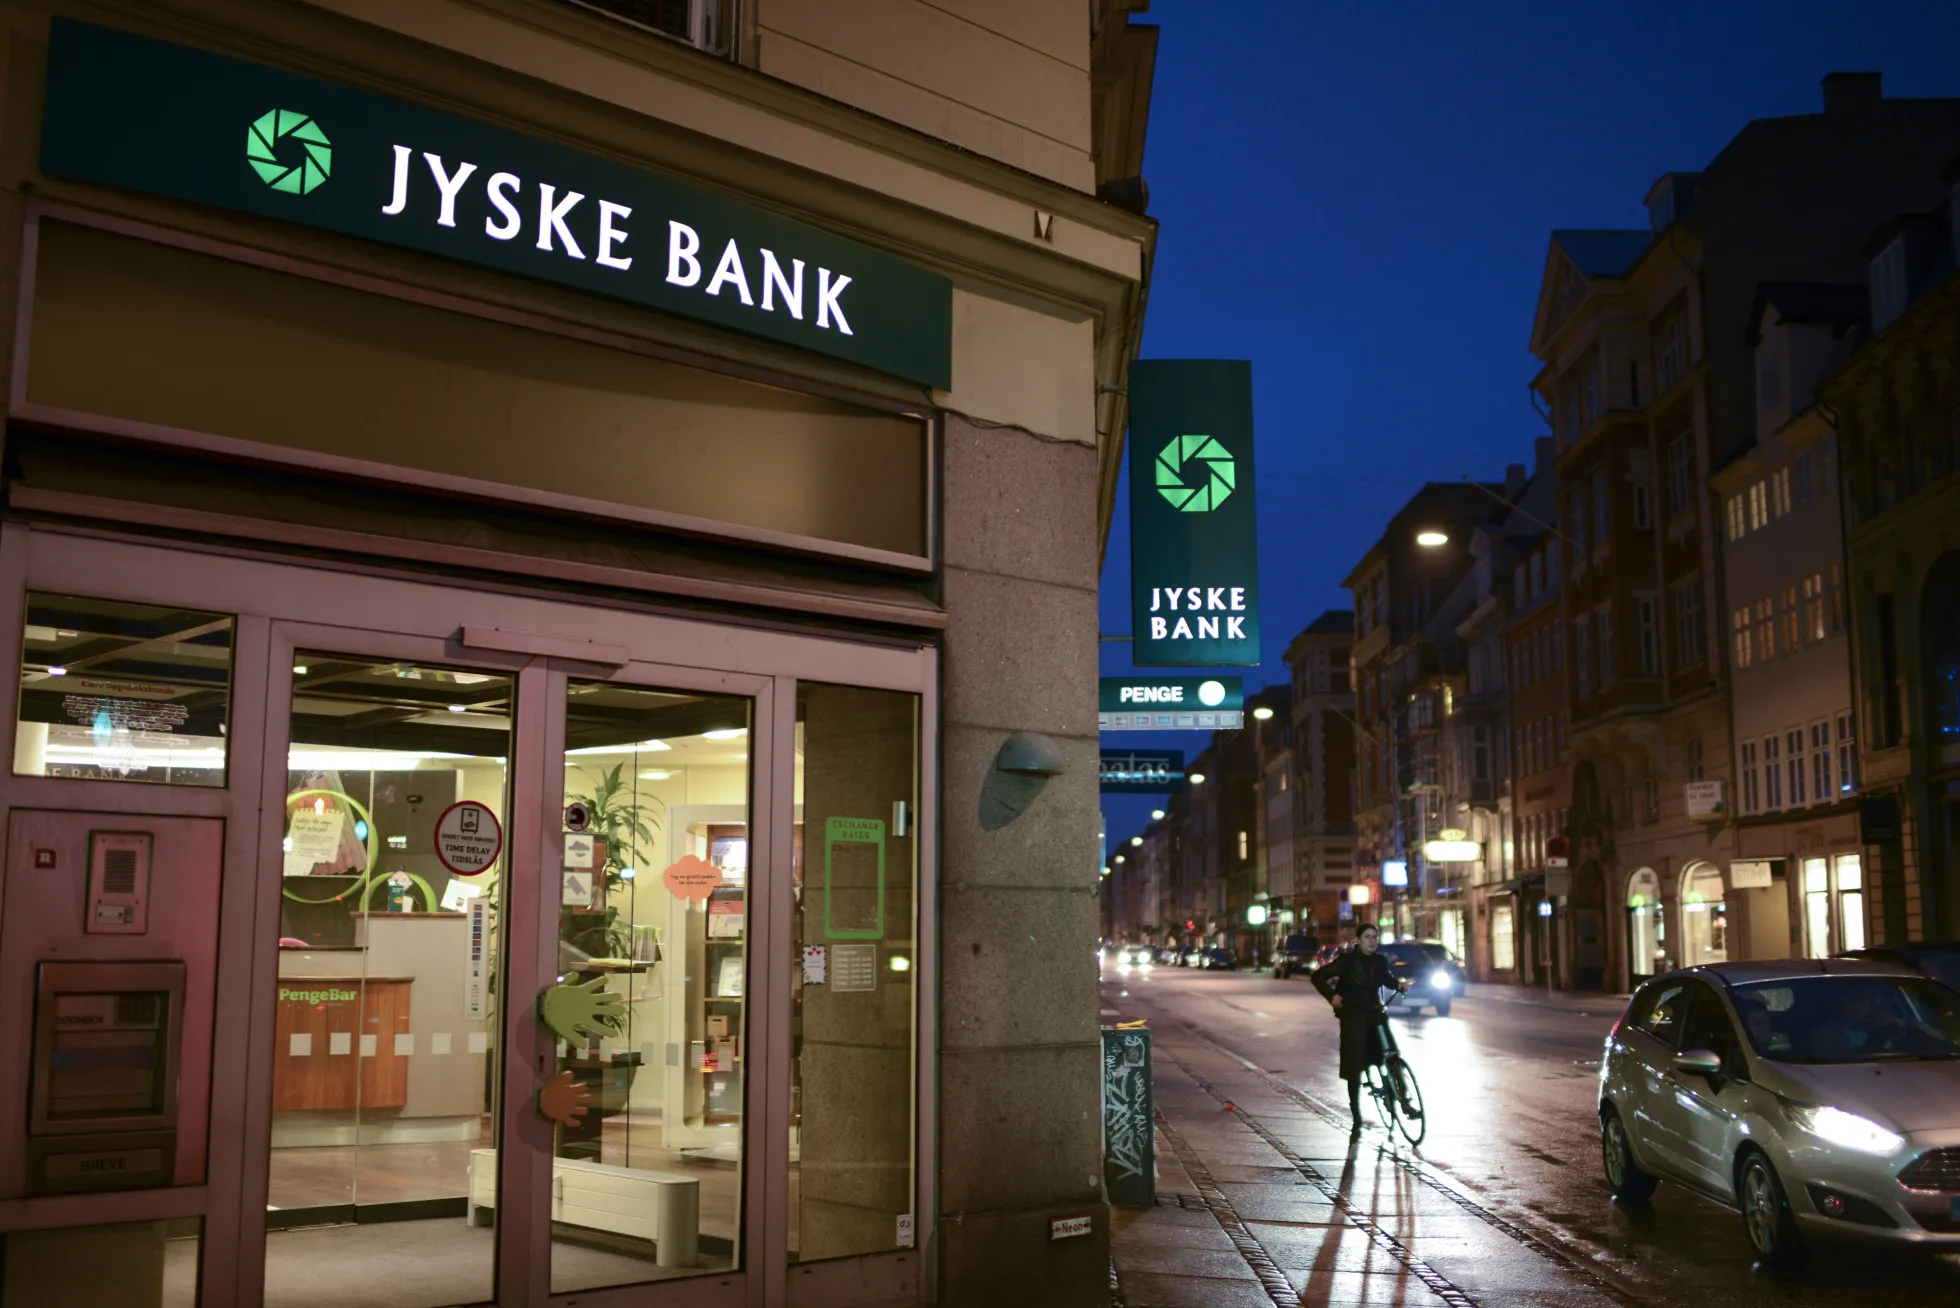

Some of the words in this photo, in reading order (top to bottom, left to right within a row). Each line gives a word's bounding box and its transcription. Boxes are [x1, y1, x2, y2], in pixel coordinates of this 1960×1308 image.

[382, 145, 632, 270] JYSKE
[666, 221, 854, 336] BANK
[1150, 587, 1246, 611] JYSKE
[1150, 616, 1247, 640] BANK
[1120, 686, 1184, 703] PENGE
[832, 820, 880, 831] EXCHANGE
[842, 831, 870, 840] RATES
[445, 844, 464, 853] TIME
[466, 846, 490, 855] DELAY
[451, 855, 483, 865] TIDSLÅS
[278, 988, 358, 1005] PengeBar
[80, 1157, 127, 1173] BREVE
[1061, 1221, 1083, 1234] Neon
